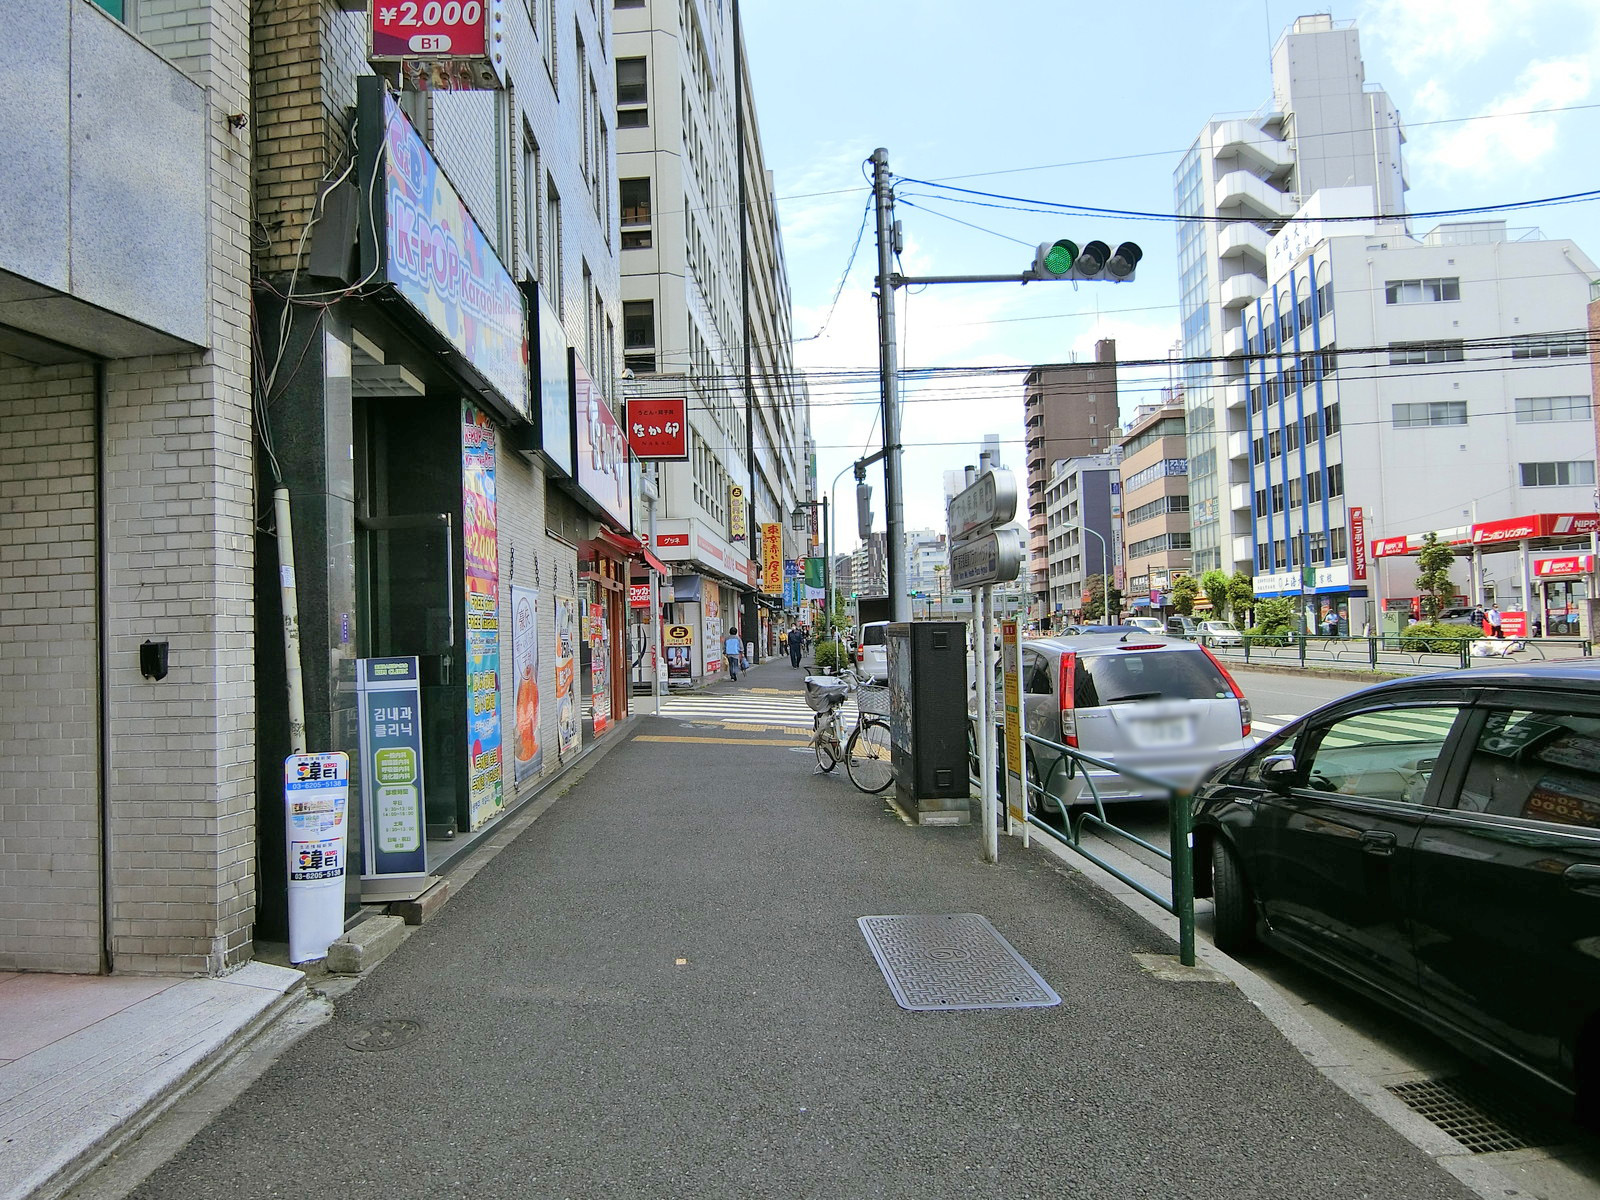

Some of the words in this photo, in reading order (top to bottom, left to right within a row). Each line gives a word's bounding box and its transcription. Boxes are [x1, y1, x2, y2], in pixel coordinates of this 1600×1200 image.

[379, 1, 481, 27] ¥2,000
[421, 38, 441, 49] B1
[396, 200, 459, 292] K-POP
[633, 422, 680, 439] なか卯
[374, 707, 412, 721] 김내과
[375, 723, 412, 737] 클리닉
